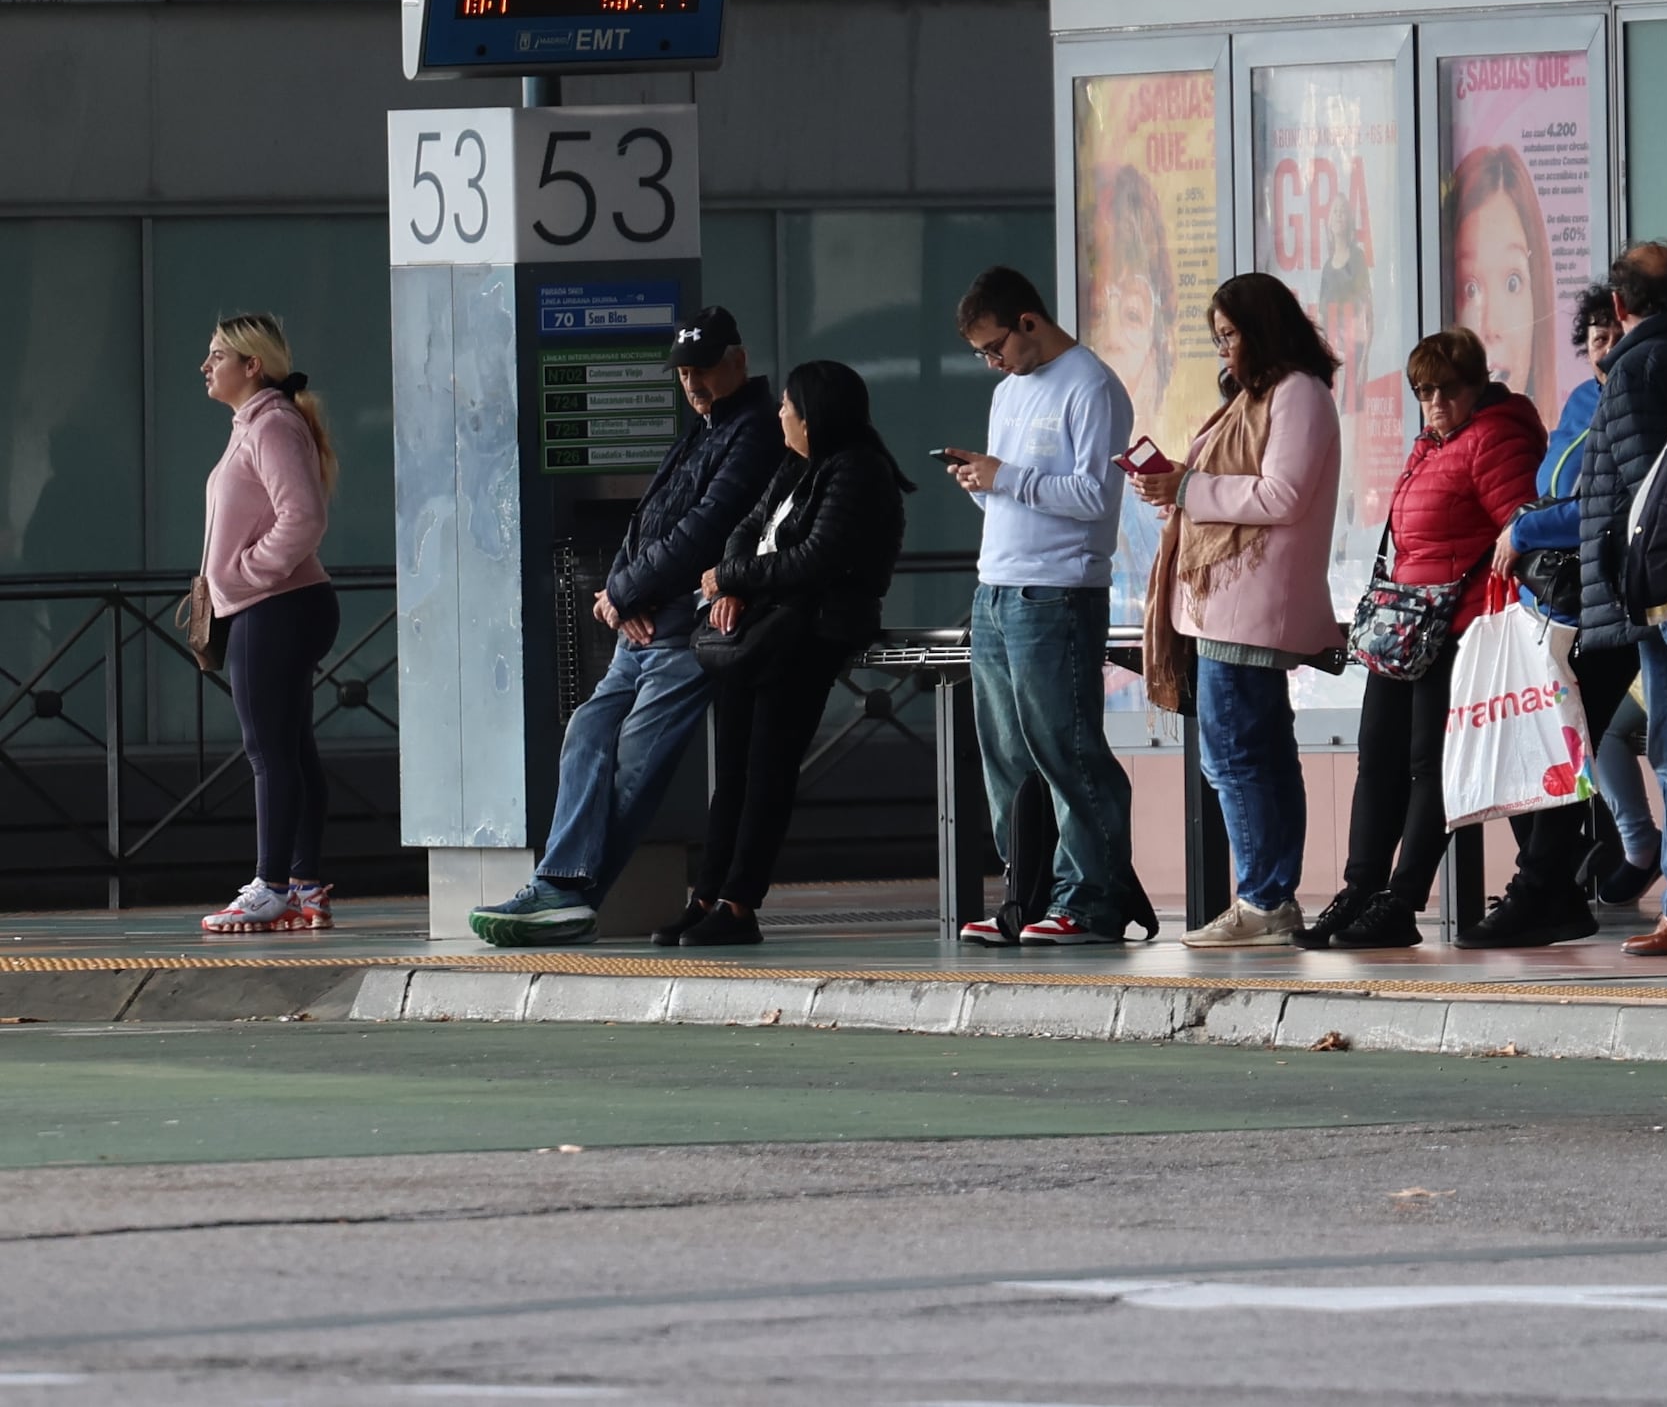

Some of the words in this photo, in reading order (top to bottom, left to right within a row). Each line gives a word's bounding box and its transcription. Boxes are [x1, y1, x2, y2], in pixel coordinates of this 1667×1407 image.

[576, 28, 630, 51] EMT
[1535, 55, 1586, 91] QUE...
[1547, 122, 1577, 138] 4.200
[410, 129, 488, 245] 53
[532, 127, 675, 246] 53
[1563, 226, 1586, 242] 60%
[554, 313, 575, 327] 70
[588, 312, 606, 324] San
[609, 311, 628, 324] Blas
